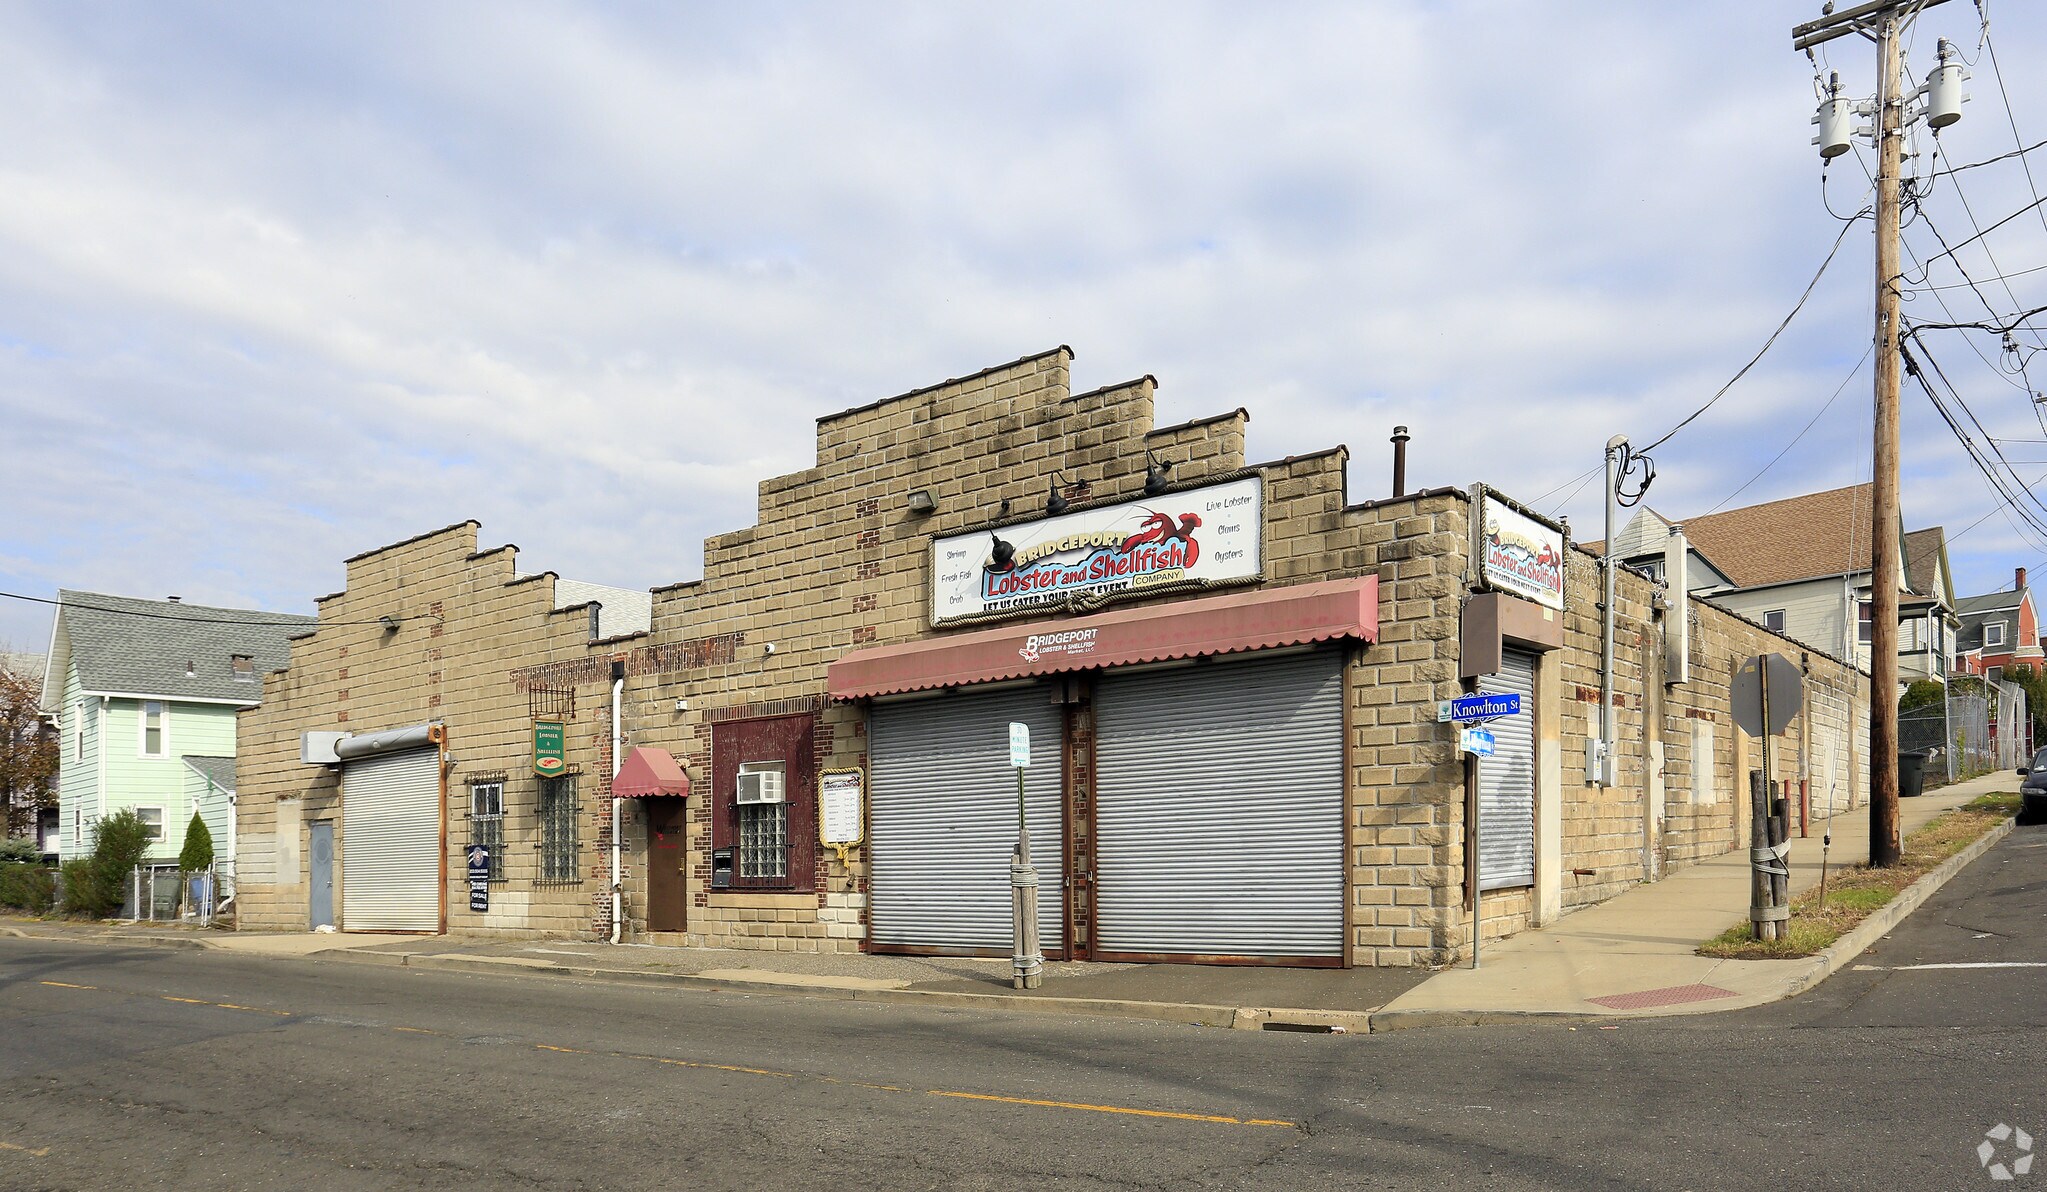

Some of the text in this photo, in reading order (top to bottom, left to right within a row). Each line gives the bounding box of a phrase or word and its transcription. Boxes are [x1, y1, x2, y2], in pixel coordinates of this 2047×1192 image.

[1206, 496, 1252, 511] Live Lobster
[1217, 523, 1241, 536] Clams
[946, 550, 967, 560] Shrimp
[1015, 532, 1128, 567] BRIDGEPORT
[1214, 549, 1244, 564] Oysters
[987, 542, 1183, 597] Lobster and Shellfish
[1488, 543, 1557, 591] Lobster and Shellfish
[941, 571, 972, 584] Fresh Fish
[1135, 571, 1180, 585] COMPANY
[949, 595, 964, 604] Crab
[983, 602, 999, 611] LET
[1000, 599, 1011, 609] US
[1012, 595, 1041, 607] CATER
[1043, 590, 1070, 600] YOUR
[1097, 581, 1129, 594] EVENT
[1026, 628, 1098, 654] BRIDGEPORT
[1067, 641, 1096, 650] SHELLFISH
[1453, 699, 1507, 717] Knowlton
[1510, 700, 1518, 709] St
